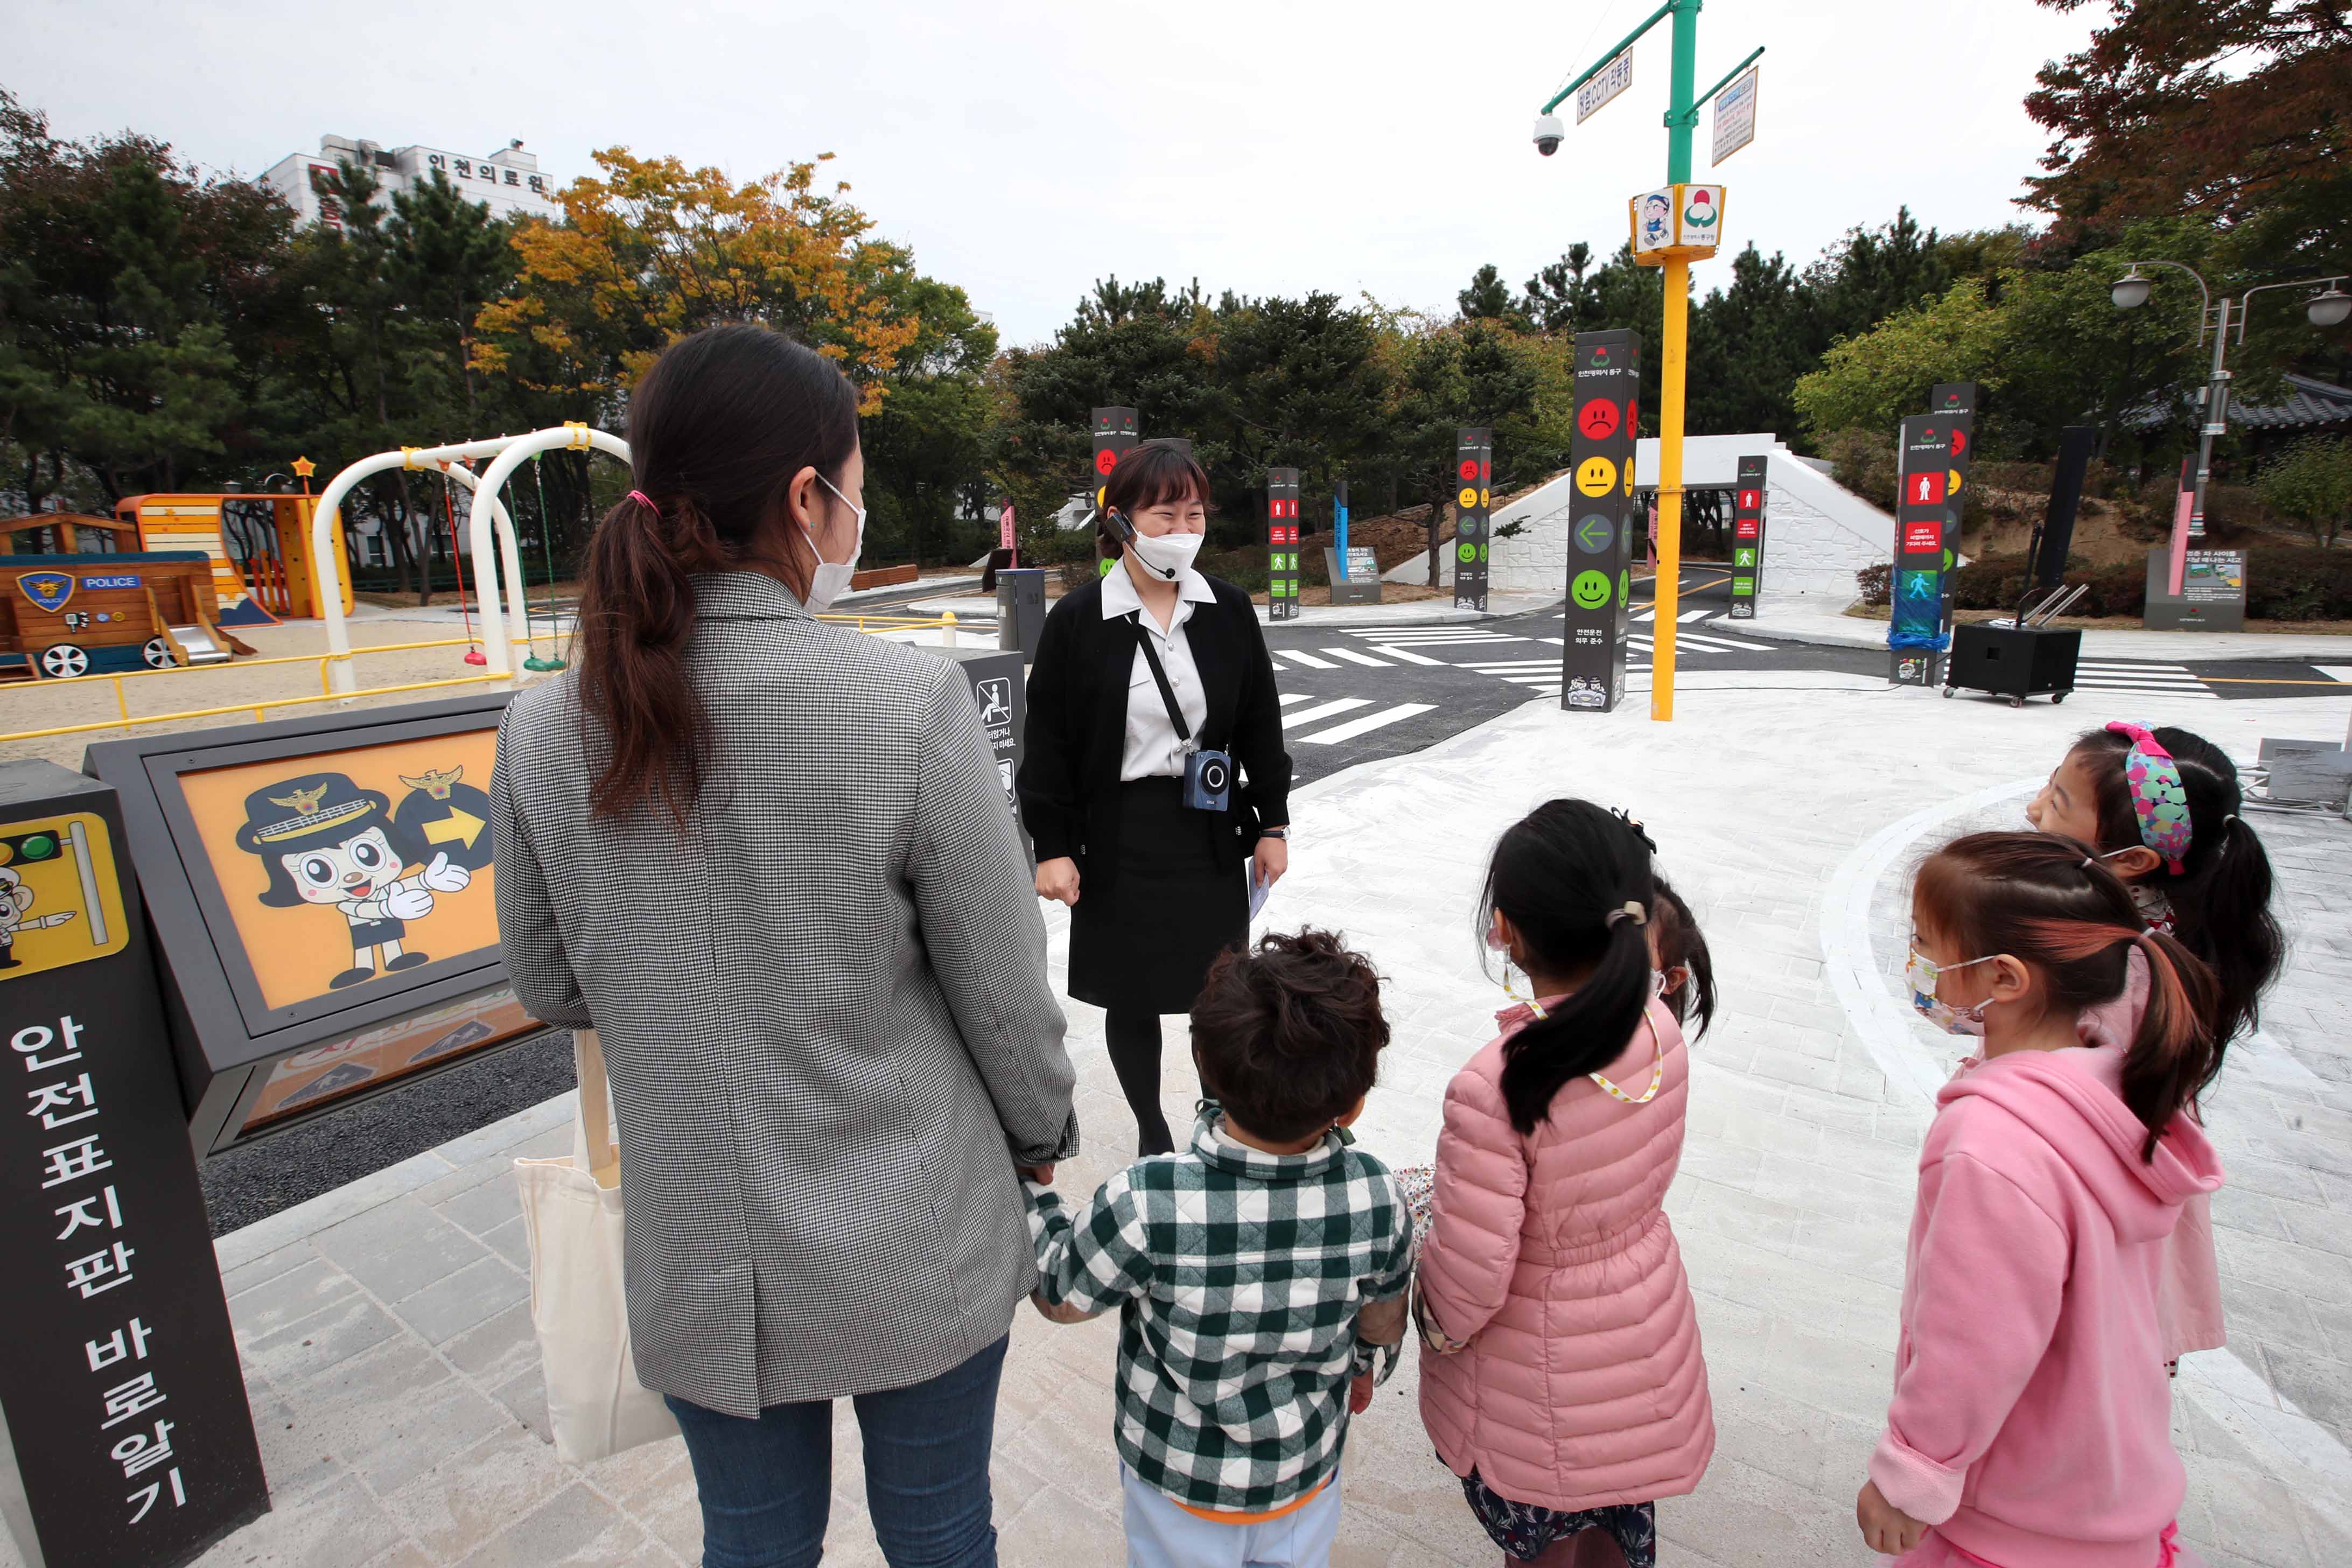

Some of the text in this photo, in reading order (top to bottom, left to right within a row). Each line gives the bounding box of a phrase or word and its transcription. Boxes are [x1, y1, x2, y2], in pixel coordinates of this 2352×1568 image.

[429, 154, 544, 194] 인천의료원
[86, 577, 136, 587] POLICE
[987, 726, 1010, 740] 터앉거나
[990, 738, 1016, 751] 지 마세요.
[11, 1016, 187, 1525] 안전표지판 바로알기
